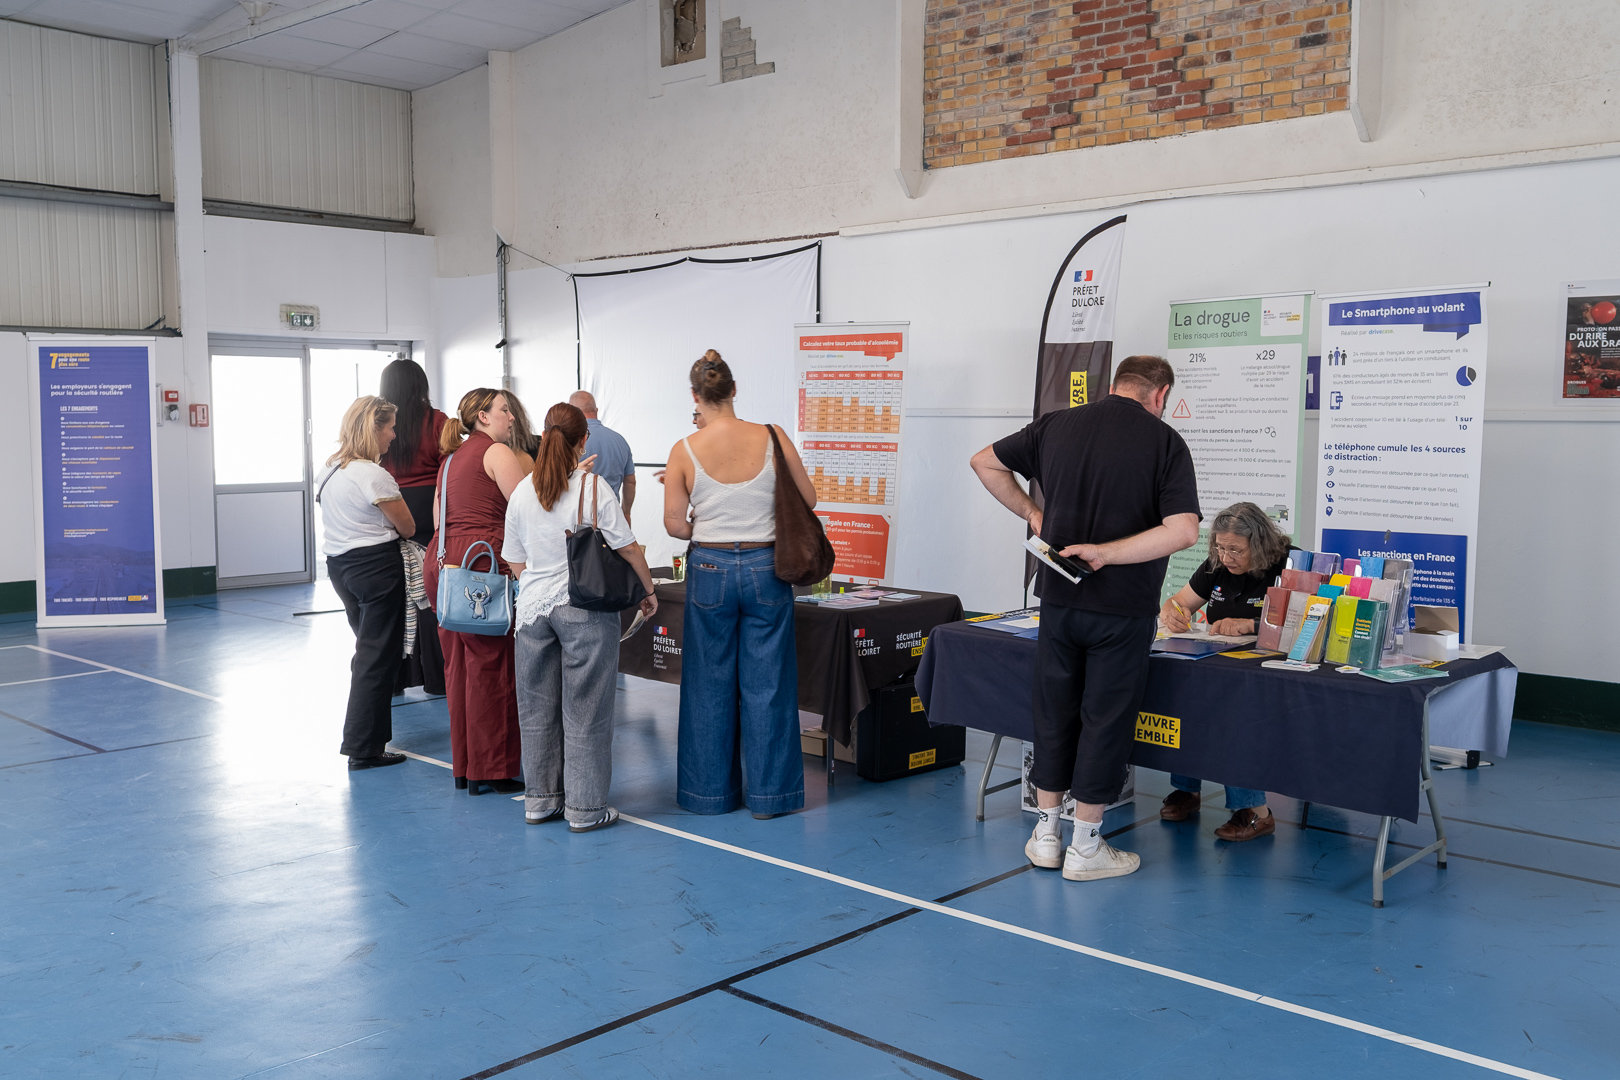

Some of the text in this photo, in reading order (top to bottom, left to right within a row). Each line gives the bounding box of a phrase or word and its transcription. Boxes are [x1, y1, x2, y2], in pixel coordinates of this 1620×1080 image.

[1073, 284, 1099, 295] PRÉFET
[1355, 306, 1415, 317] Smartphone
[1432, 303, 1465, 313] volant
[1175, 313, 1192, 326] La
[1197, 310, 1250, 328] drogue
[1194, 332, 1218, 340] risques
[1189, 353, 1206, 362] 21%
[1256, 350, 1275, 360] x29
[50, 353, 58, 369] 7
[1335, 443, 1375, 452] téléphone
[1334, 453, 1378, 461] distraction
[1372, 550, 1412, 559] sanctions
[1427, 552, 1455, 562] France
[896, 630, 921, 641] SÉCURITÉ
[654, 636, 675, 646] PRÉFÈTE
[855, 639, 874, 648] ÉFÈTE
[896, 639, 921, 649] ROUTIÈRE
[662, 645, 682, 655] LOIRET
[858, 647, 880, 656] LOIRET
[1140, 714, 1178, 733] VIVRE,
[1137, 728, 1174, 745] EMBLE
